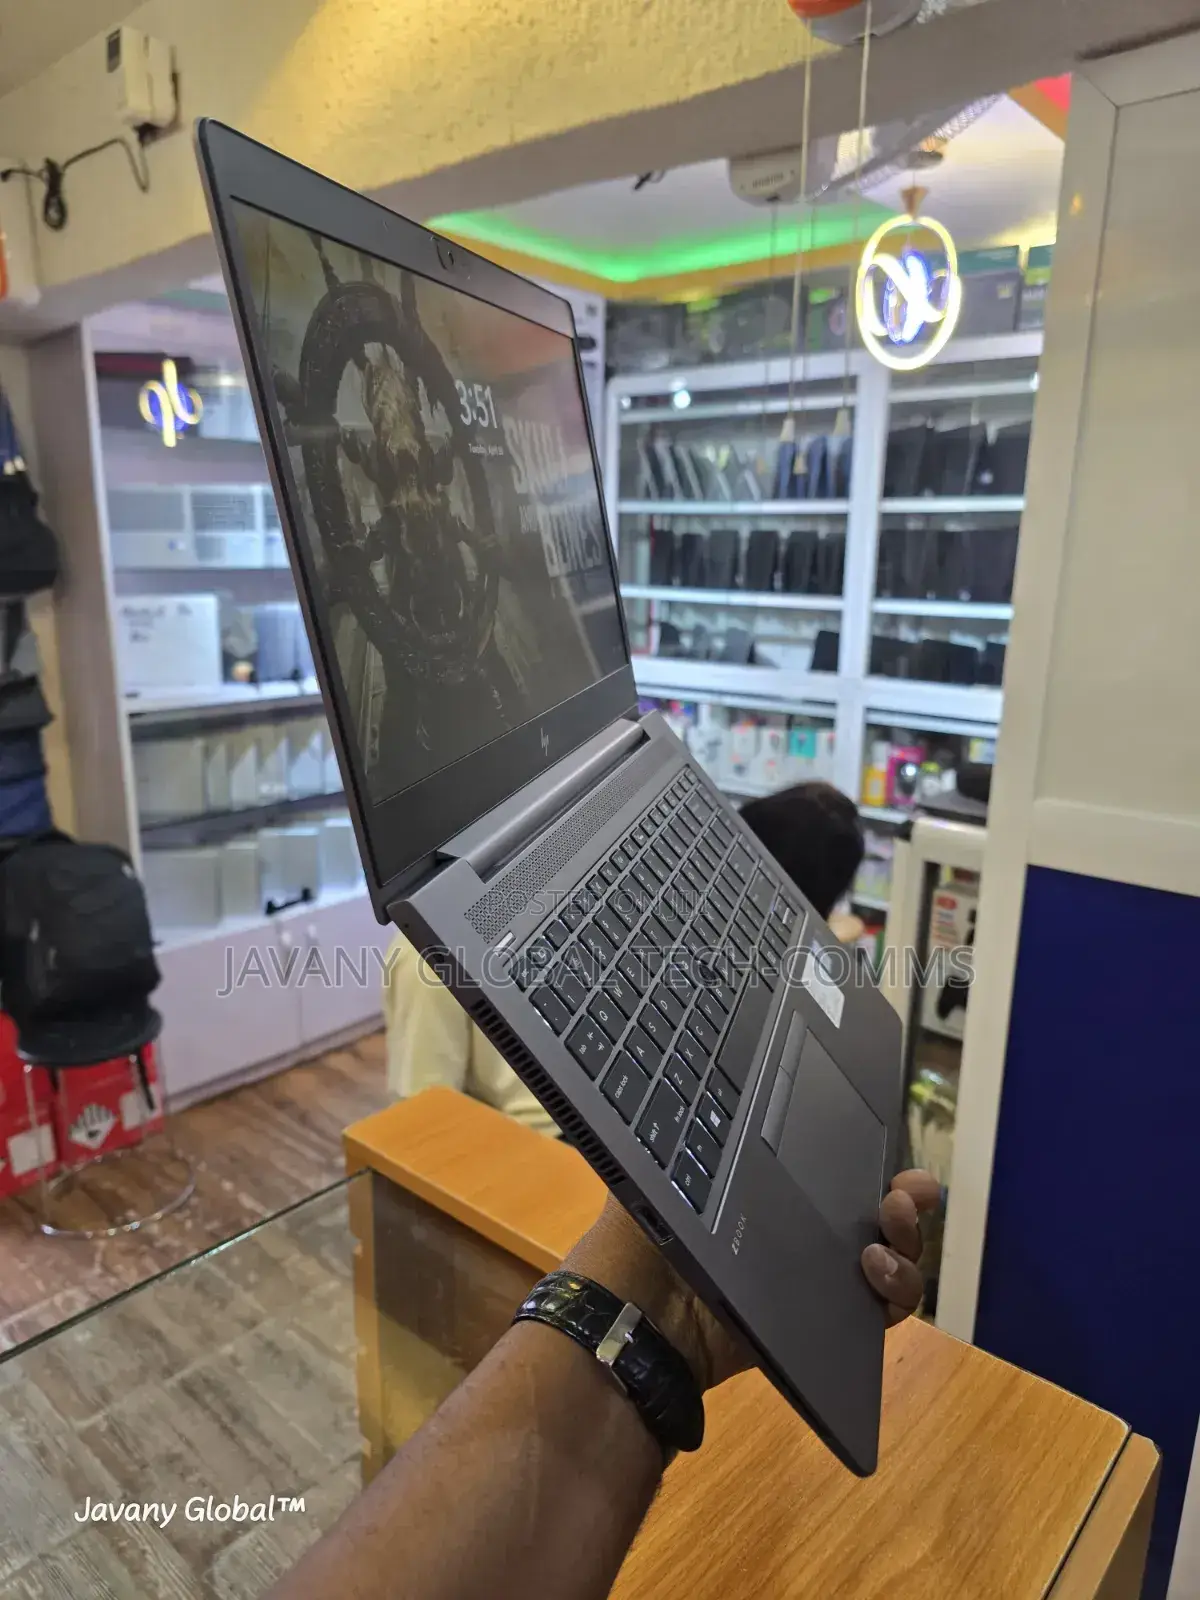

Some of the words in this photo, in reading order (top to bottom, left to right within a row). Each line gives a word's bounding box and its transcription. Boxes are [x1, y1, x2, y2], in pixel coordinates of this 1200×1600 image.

[456, 380, 498, 428] 3:51
[626, 966, 635, 977] E
[613, 984, 623, 998] W
[660, 1000, 668, 1010] D
[599, 1011, 608, 1022] Q
[648, 1022, 656, 1032] S
[695, 1026, 703, 1036] C
[636, 1046, 644, 1057] A
[685, 1048, 693, 1058] X
[675, 1073, 683, 1084] Z
